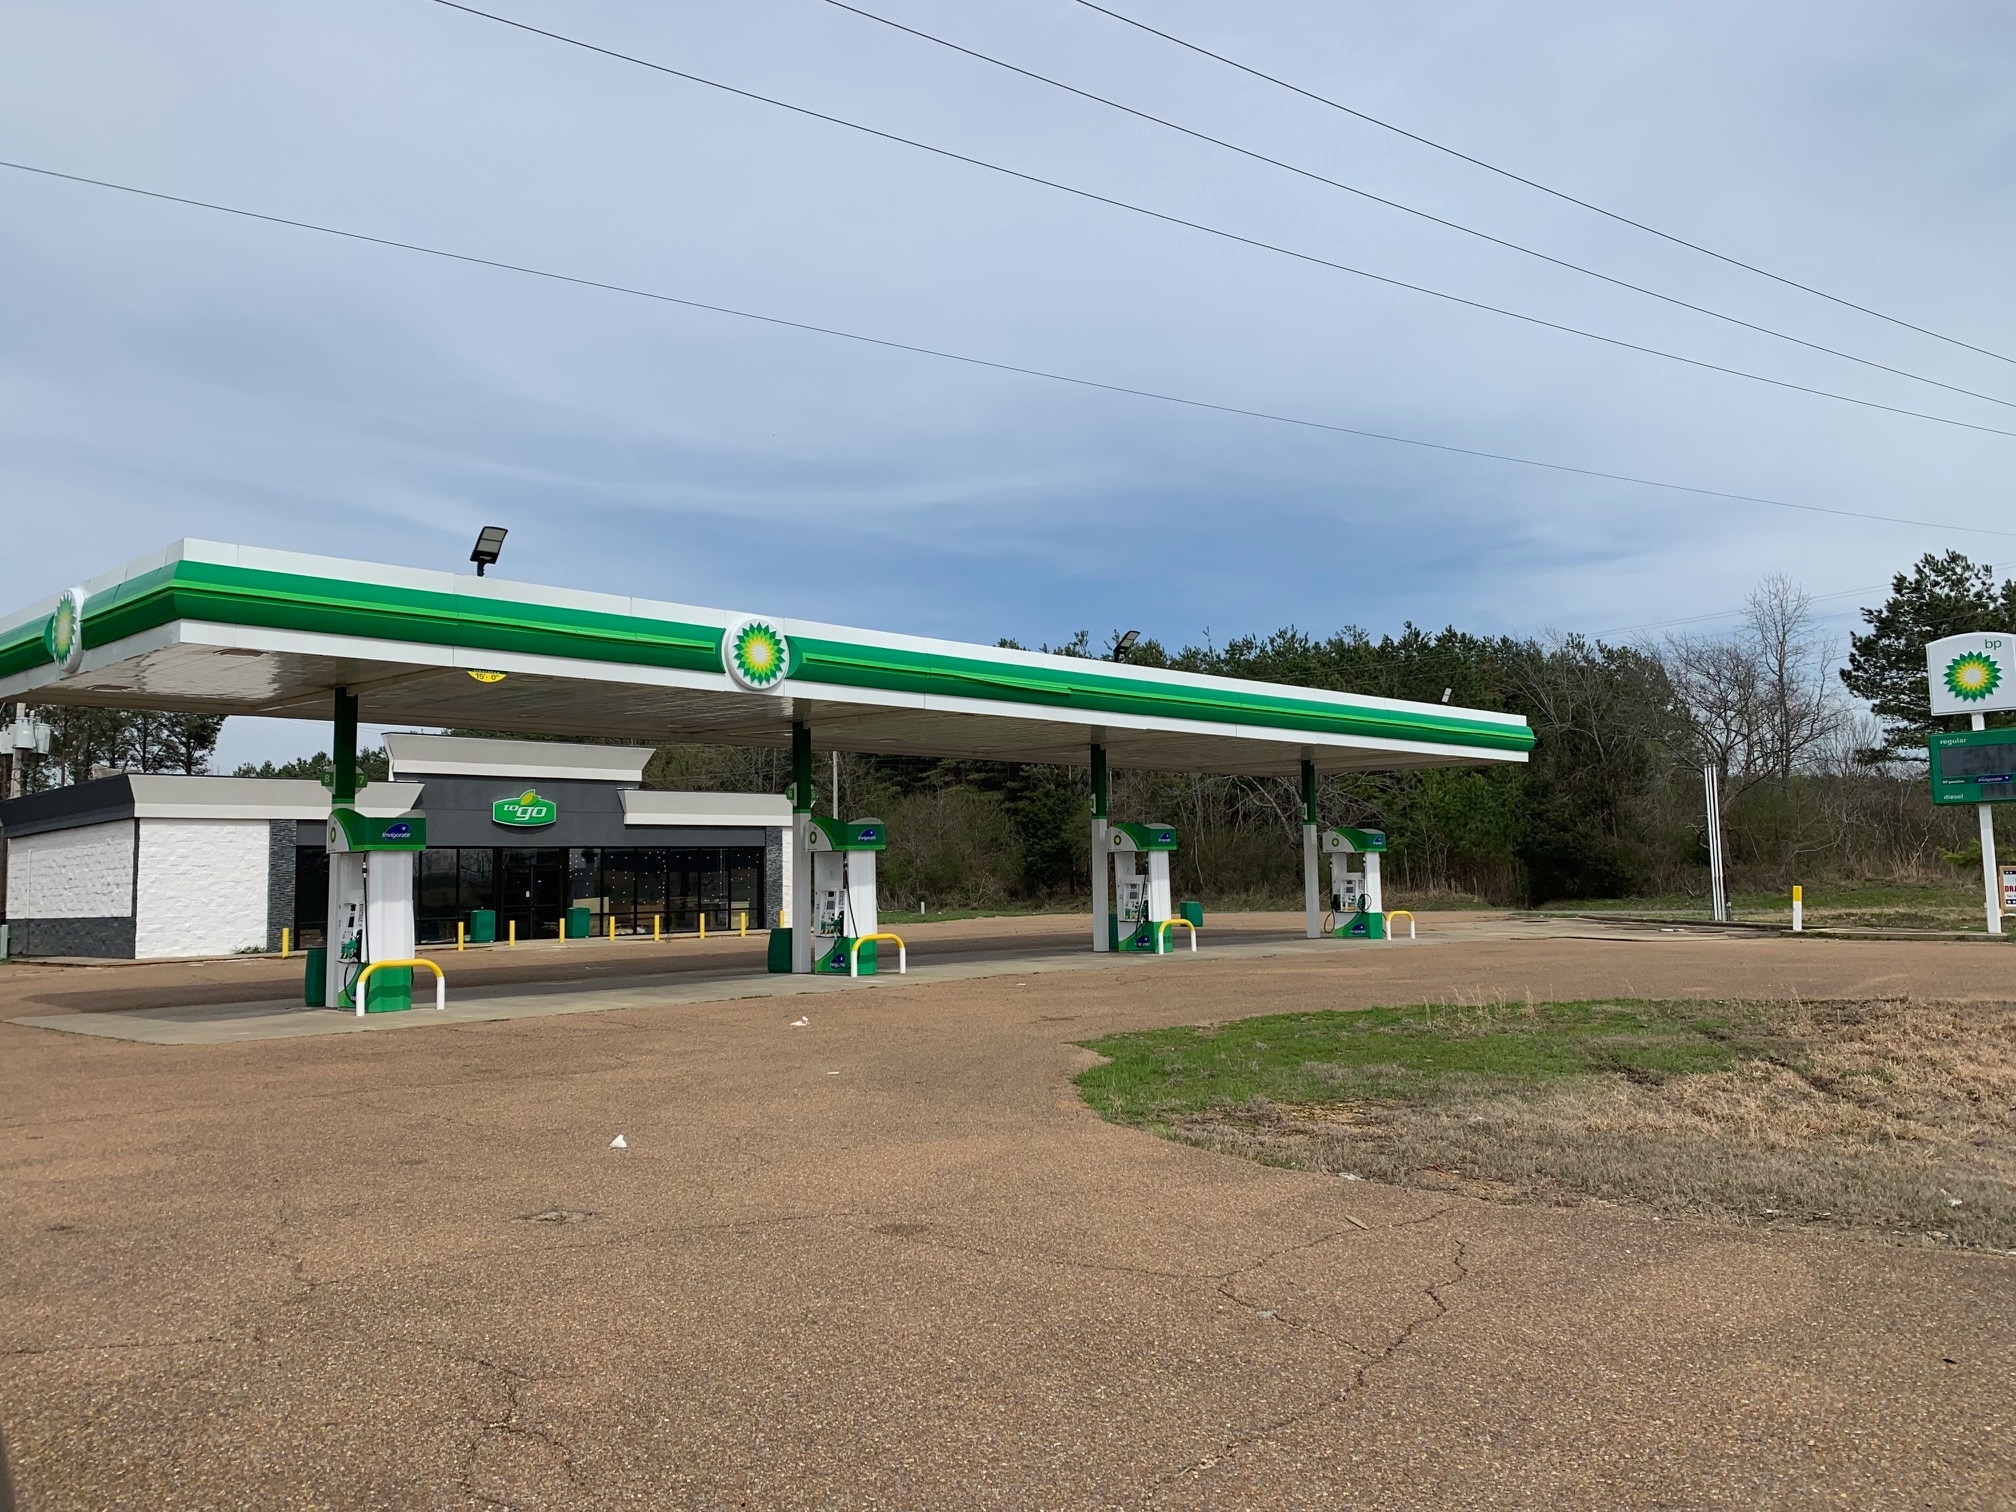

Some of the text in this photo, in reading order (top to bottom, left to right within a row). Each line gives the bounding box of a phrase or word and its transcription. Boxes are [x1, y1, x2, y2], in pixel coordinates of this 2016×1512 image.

[1984, 639, 2002, 651] bp
[1940, 738, 1967, 746] regular
[324, 774, 330, 783] 8
[358, 775, 365, 784] 7
[788, 789, 793, 797] 6
[514, 806, 547, 821] go
